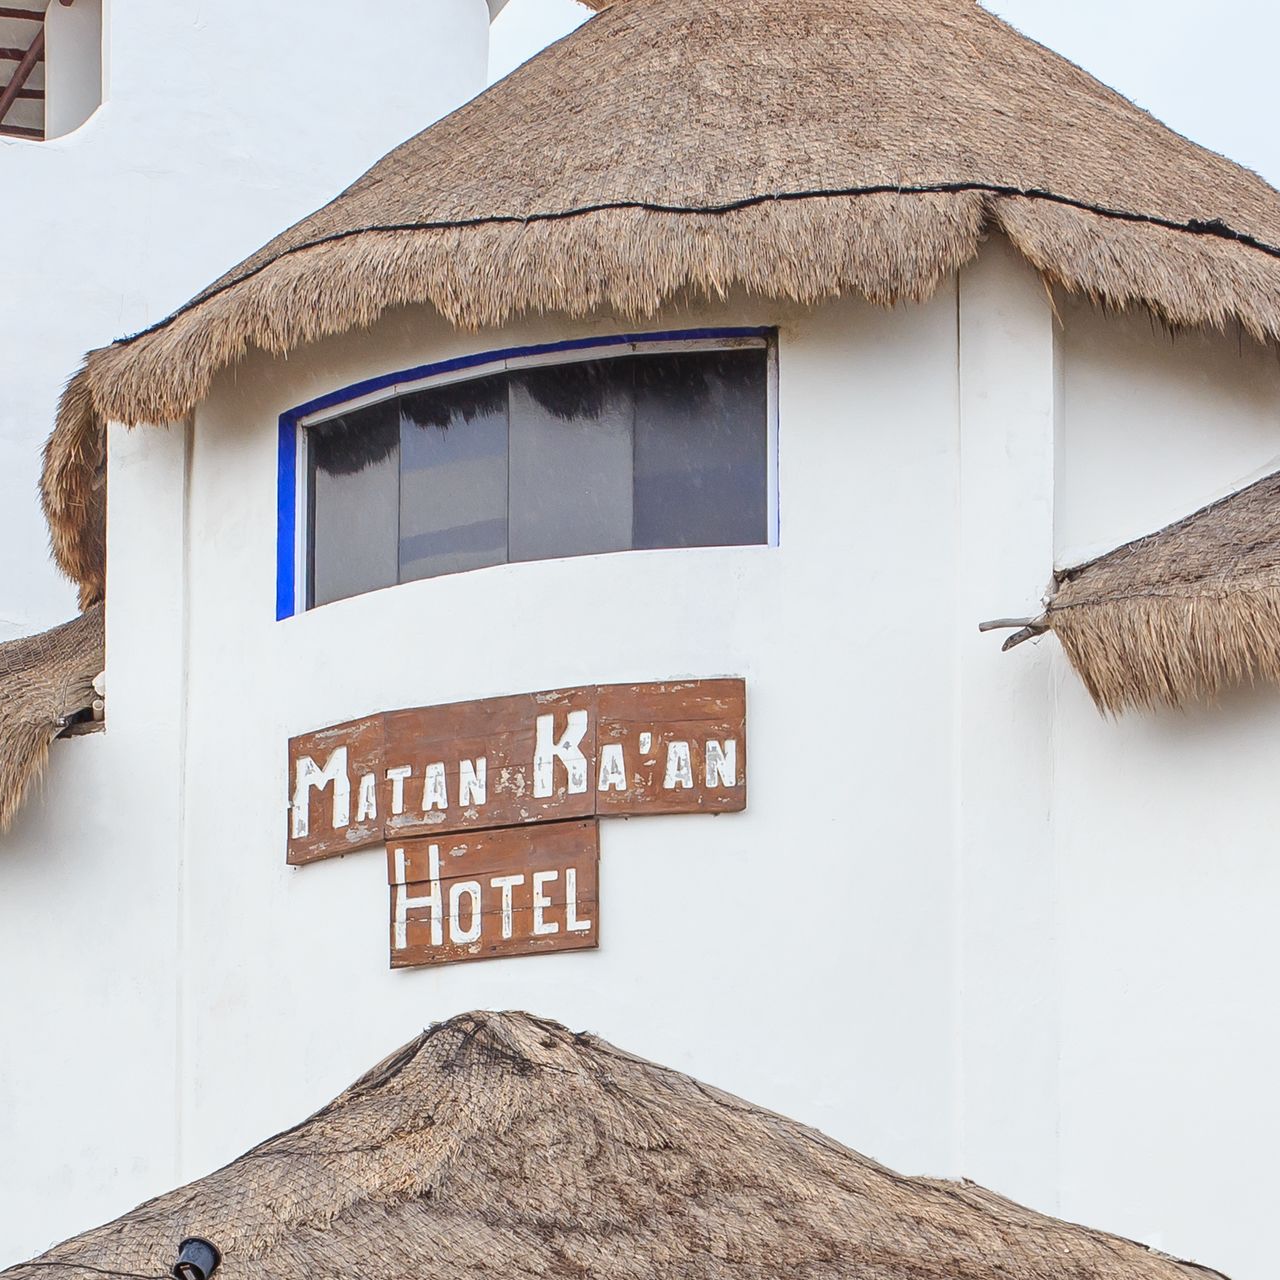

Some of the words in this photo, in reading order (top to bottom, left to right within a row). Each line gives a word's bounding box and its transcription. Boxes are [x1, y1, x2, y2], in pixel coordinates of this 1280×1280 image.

[291, 746, 487, 839] MATAN
[533, 709, 737, 798] KA'AN
[394, 844, 591, 949] HOTEL
